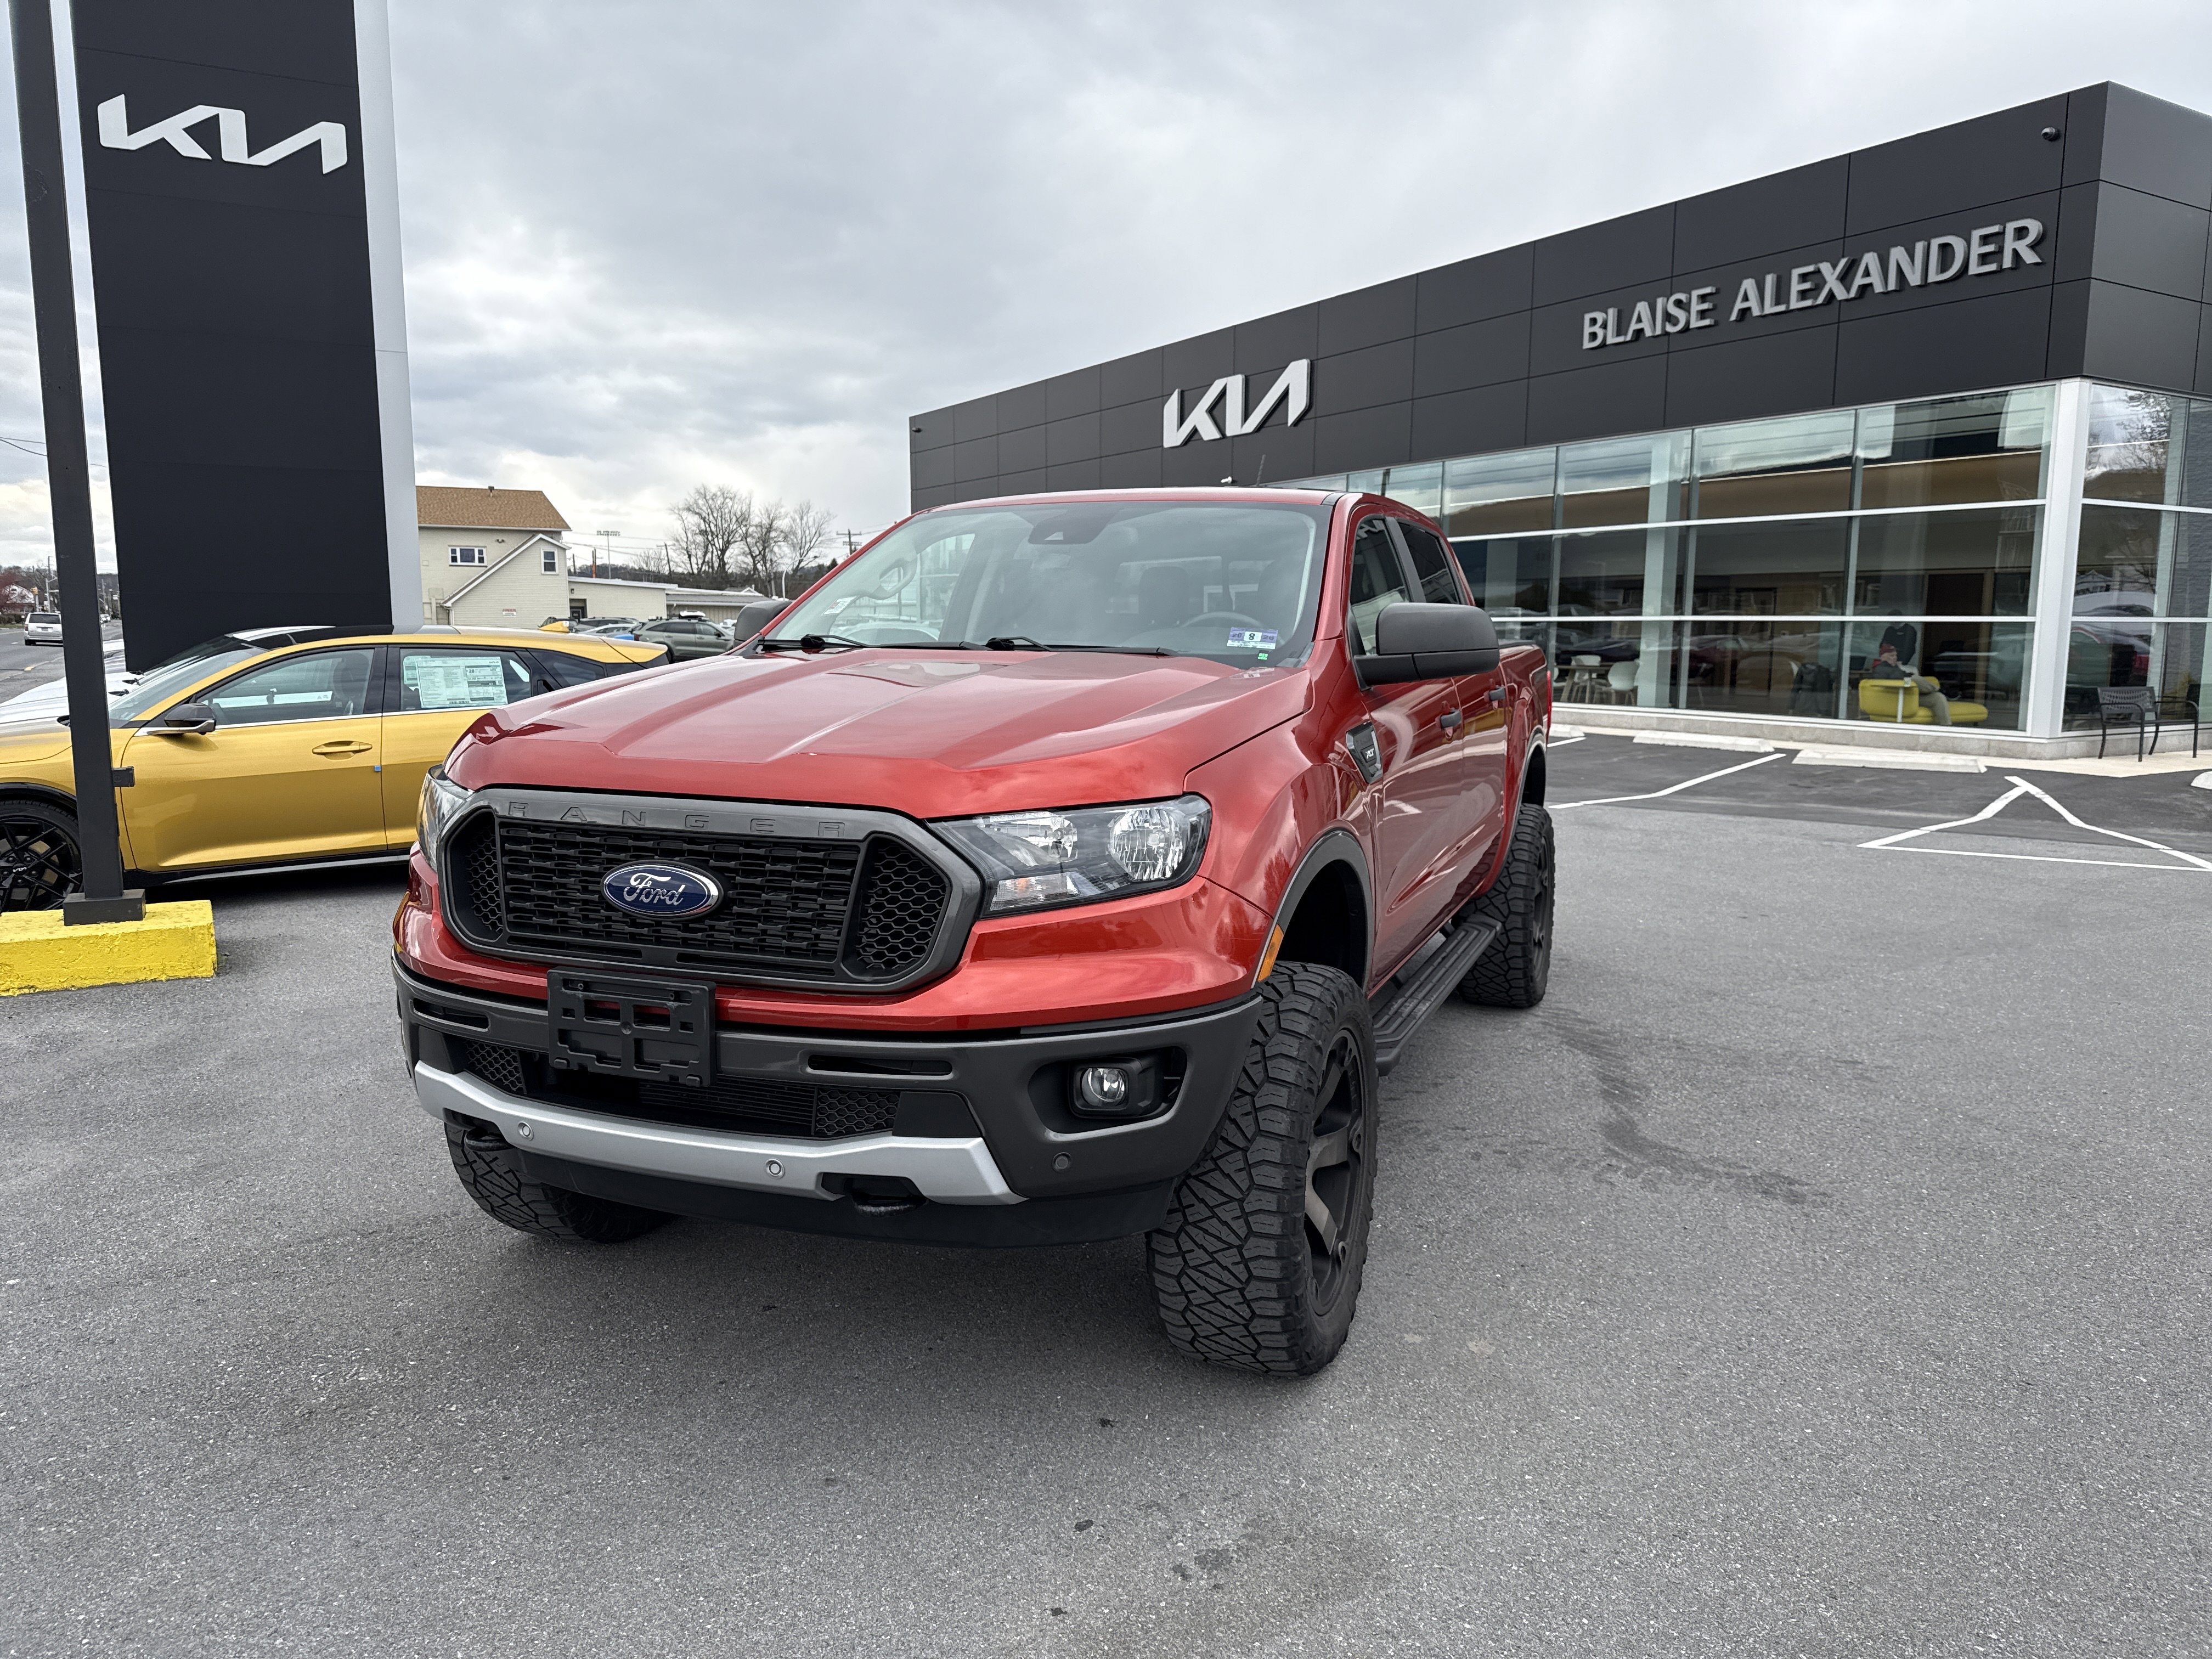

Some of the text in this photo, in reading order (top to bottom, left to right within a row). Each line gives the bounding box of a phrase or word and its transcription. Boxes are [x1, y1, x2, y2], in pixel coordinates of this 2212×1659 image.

[98, 93, 348, 174] KIA
[1582, 218, 2043, 350] BLAISE ALEXANDER
[1163, 358, 1311, 448] KIA
[508, 801, 845, 837] RANGER
[623, 872, 686, 905] Ford
